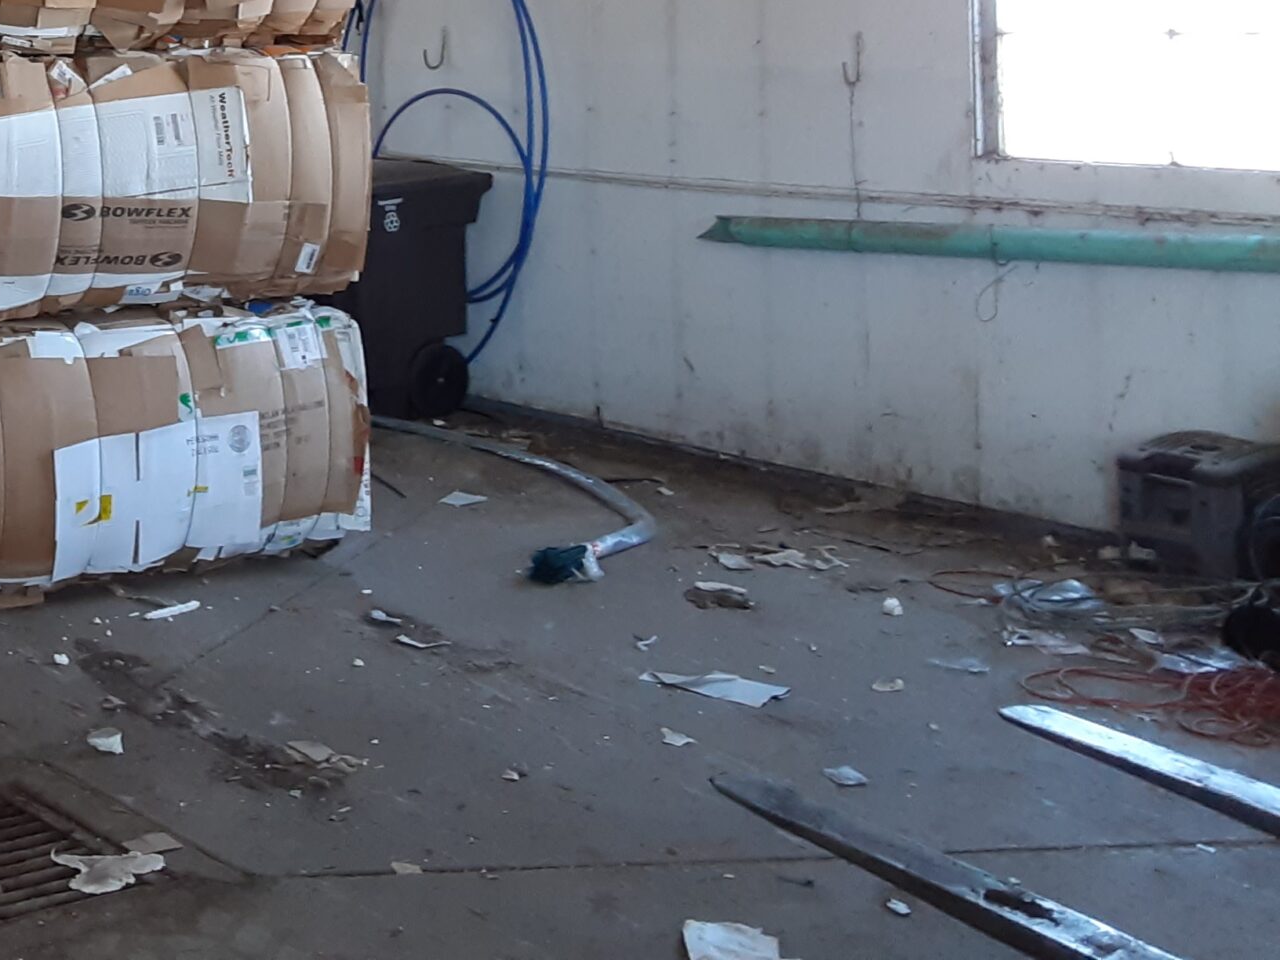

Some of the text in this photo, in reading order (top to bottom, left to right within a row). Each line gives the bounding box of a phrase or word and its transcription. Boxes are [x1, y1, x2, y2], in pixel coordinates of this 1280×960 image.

[218, 91, 236, 178] WeatherTech
[99, 206, 193, 218] BOWFLEX
[54, 254, 148, 266] BOWFLEX
